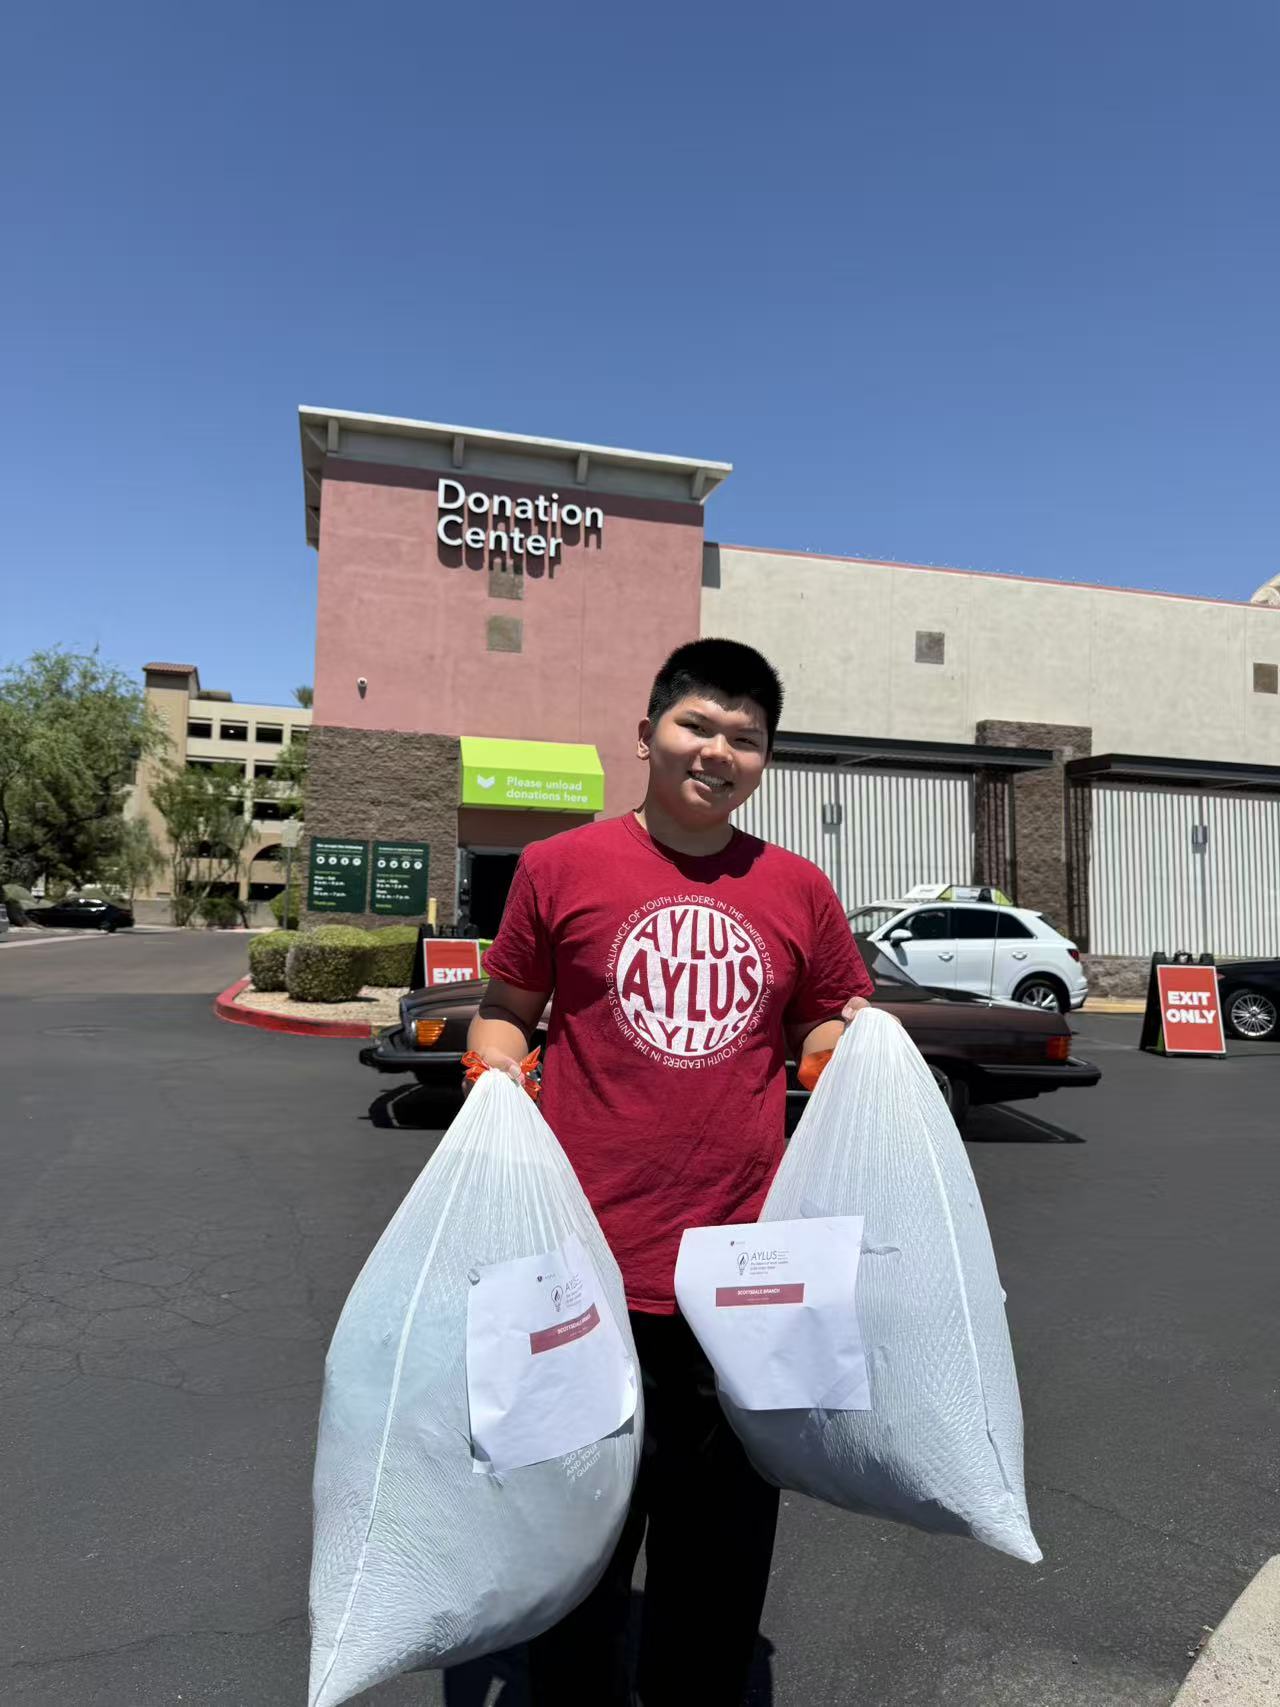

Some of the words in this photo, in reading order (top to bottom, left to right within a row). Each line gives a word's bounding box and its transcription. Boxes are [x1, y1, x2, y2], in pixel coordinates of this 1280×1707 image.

[438, 478, 604, 528] Donation
[437, 514, 563, 557] Center
[506, 775, 542, 789] Please
[546, 779, 583, 792] unload
[506, 789, 562, 801] donations
[564, 792, 589, 804] here
[606, 921, 631, 970] ALLIANCE
[628, 909, 642, 924] OF
[640, 896, 672, 913] YOUTH
[673, 894, 715, 906] LEADERS
[716, 901, 728, 910] IN
[727, 905, 745, 921] THE
[742, 919, 766, 950] UNITED
[761, 951, 775, 985] STATES
[633, 908, 751, 960] AYLUS
[433, 967, 474, 984] EXIT
[621, 948, 759, 1022] AYLUS
[1167, 990, 1211, 1006] EXIT
[613, 1007, 635, 1041] UNITED
[1166, 1008, 1217, 1024] ONLY
[633, 1009, 749, 1053] AYLUS
[633, 1037, 650, 1056] THE
[737, 1033, 748, 1048] OF
[649, 1050, 662, 1062] IN
[662, 1055, 706, 1069] LEADERS
[707, 1045, 738, 1067] YOUTH
[751, 1250, 777, 1261] AYLUS
